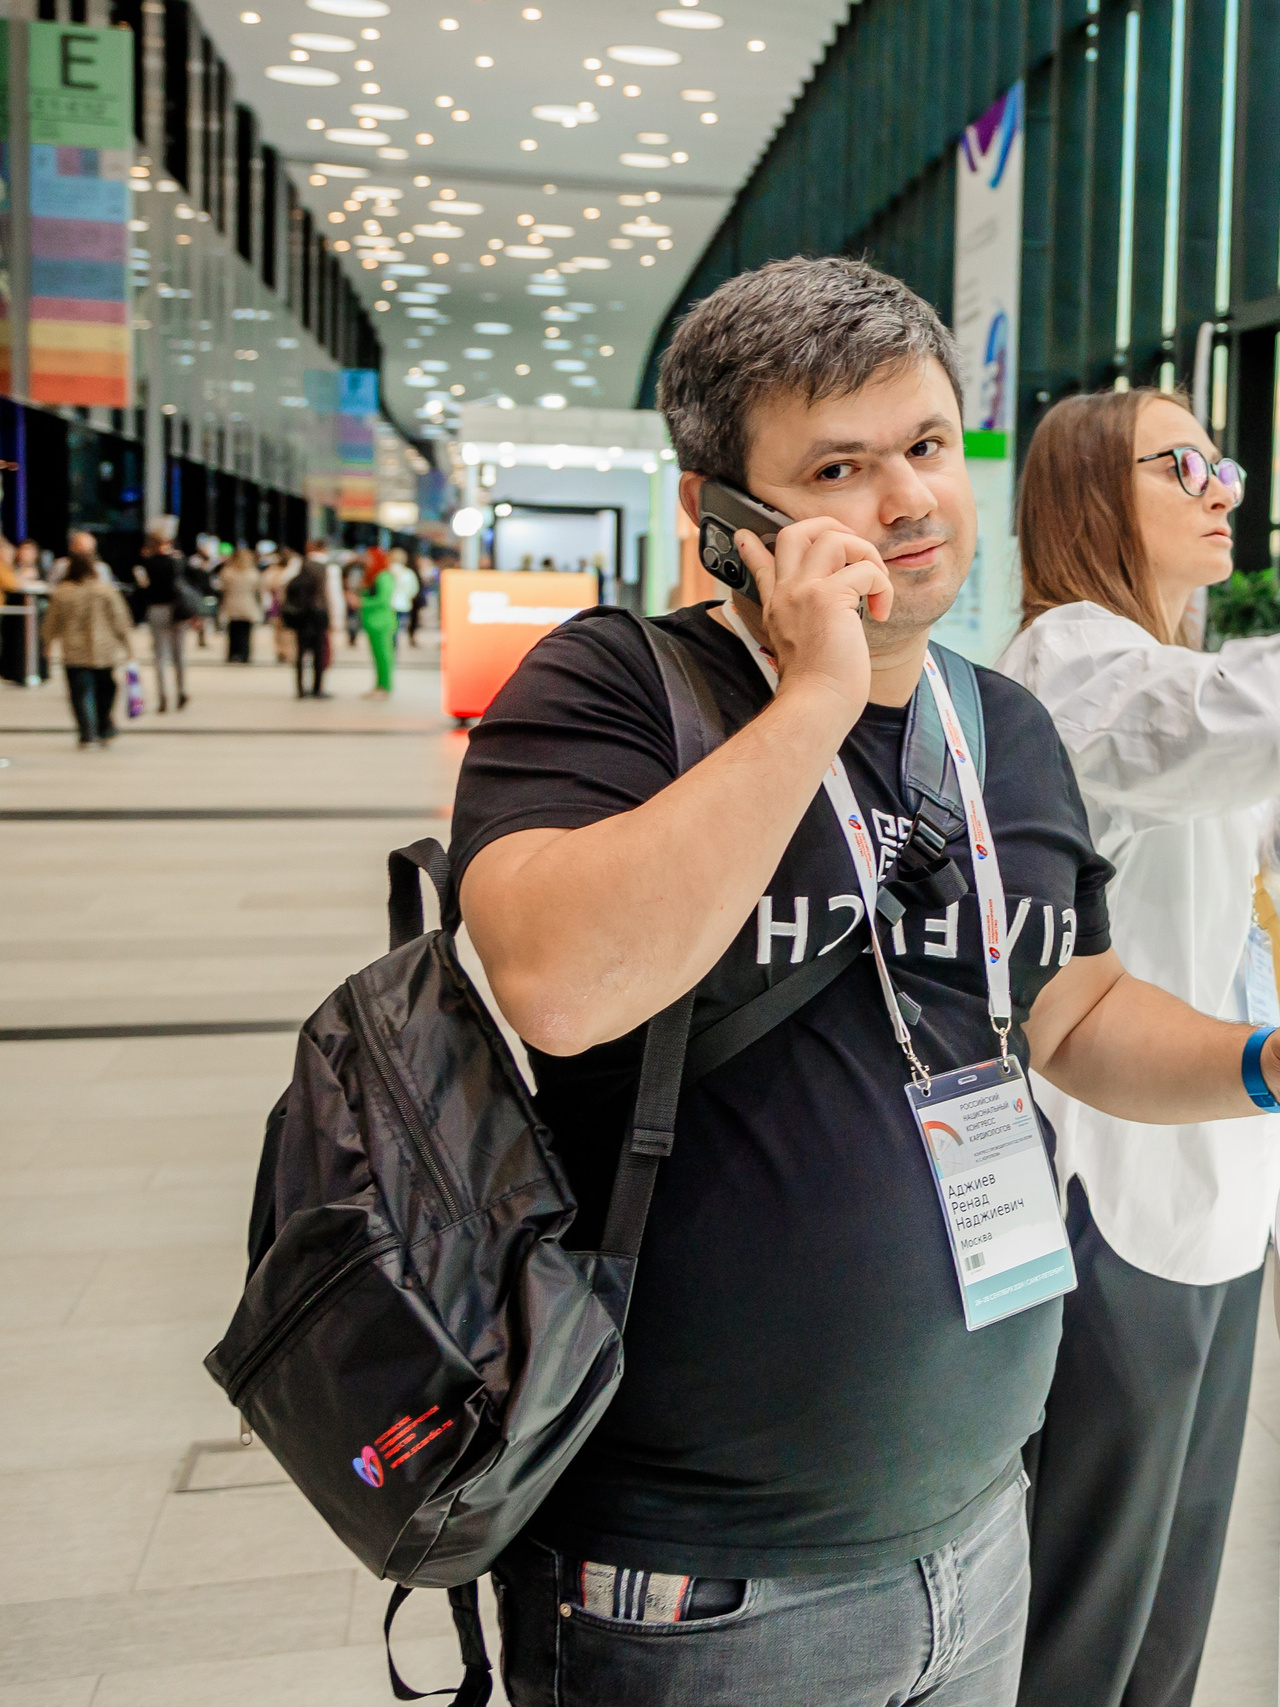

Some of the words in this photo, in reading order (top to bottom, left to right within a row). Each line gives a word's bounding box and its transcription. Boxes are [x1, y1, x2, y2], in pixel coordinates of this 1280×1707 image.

[61, 33, 98, 89] E
[959, 1093, 1000, 1111] РОССИЙСКИЙ
[962, 1101, 1009, 1121] НАЦИОНАЛЬНЫЙ
[966, 1117, 997, 1132] КОНГРЕСС
[969, 1124, 1012, 1143] КАРДИОЛОГОВ
[948, 1172, 996, 1199] Аджиев
[951, 1193, 990, 1215] Ренад
[955, 1198, 1025, 1231] Наджиевич
[960, 1231, 993, 1250] Москва
